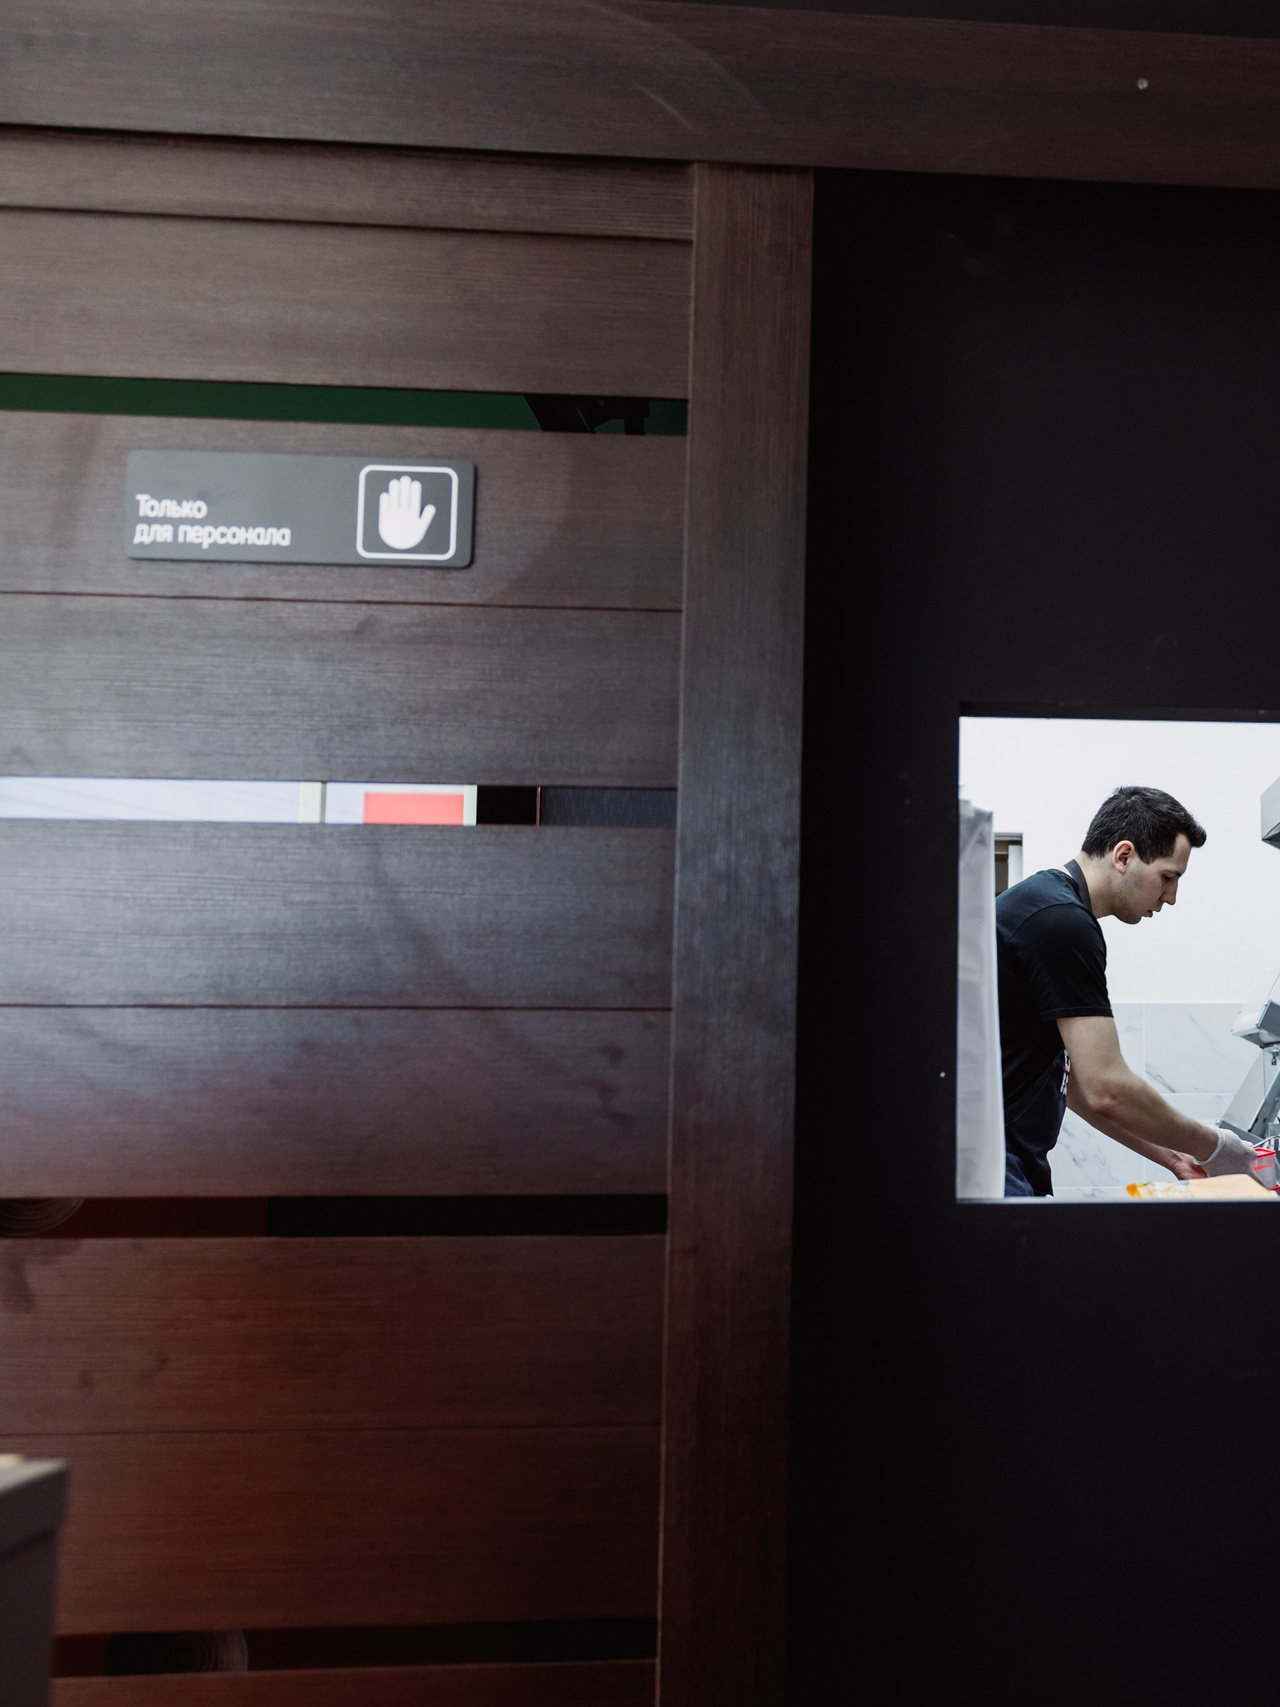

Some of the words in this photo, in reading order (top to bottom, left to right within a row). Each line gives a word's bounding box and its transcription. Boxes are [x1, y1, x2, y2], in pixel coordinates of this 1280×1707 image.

[135, 493, 208, 519] Только
[132, 523, 174, 545] для
[177, 524, 292, 550] персонала
